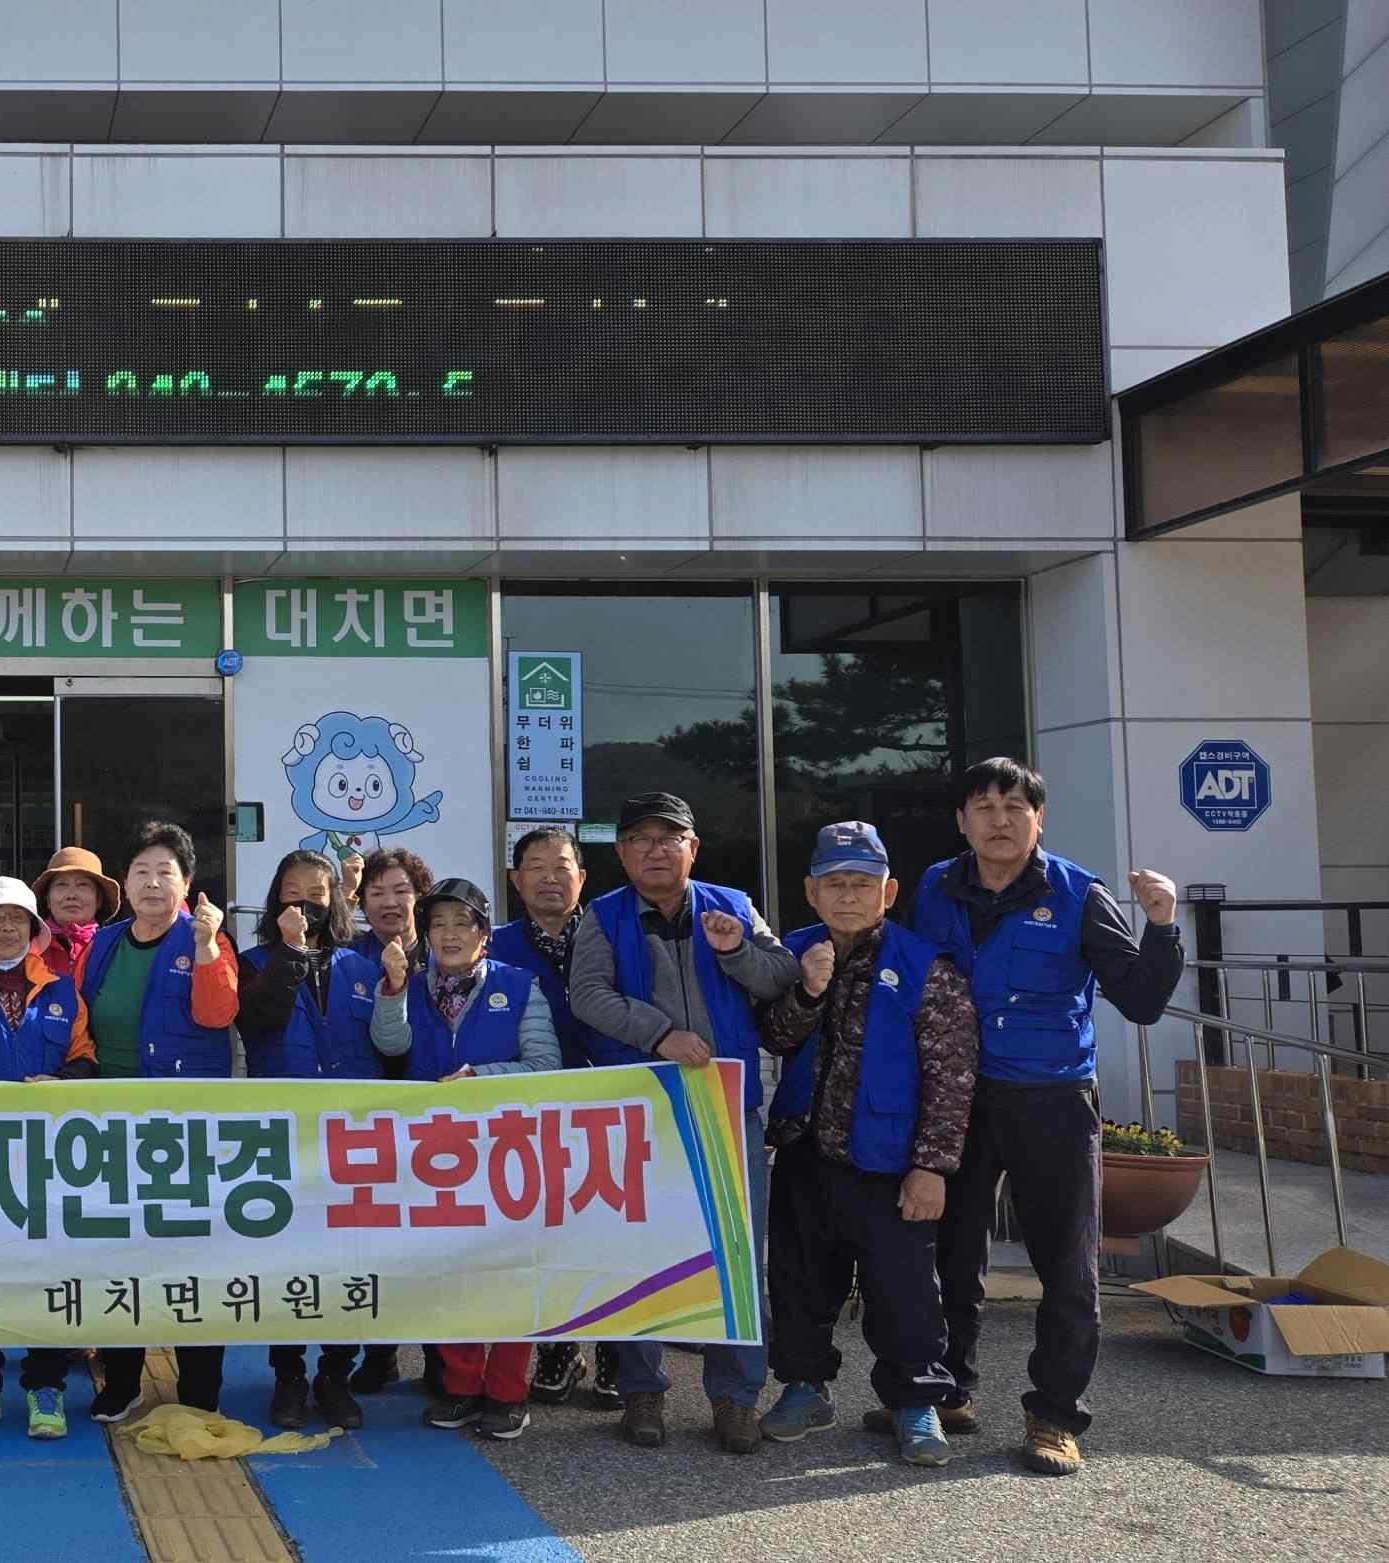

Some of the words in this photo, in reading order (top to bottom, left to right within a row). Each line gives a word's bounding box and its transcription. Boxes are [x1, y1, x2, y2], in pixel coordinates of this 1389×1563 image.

[265, 588, 455, 648] 대치면
[516, 715, 574, 731] 무더위
[1197, 769, 1255, 800] ADT
[325, 1103, 652, 1229] 보호하자
[44, 1273, 381, 1326] 대치면위원회
